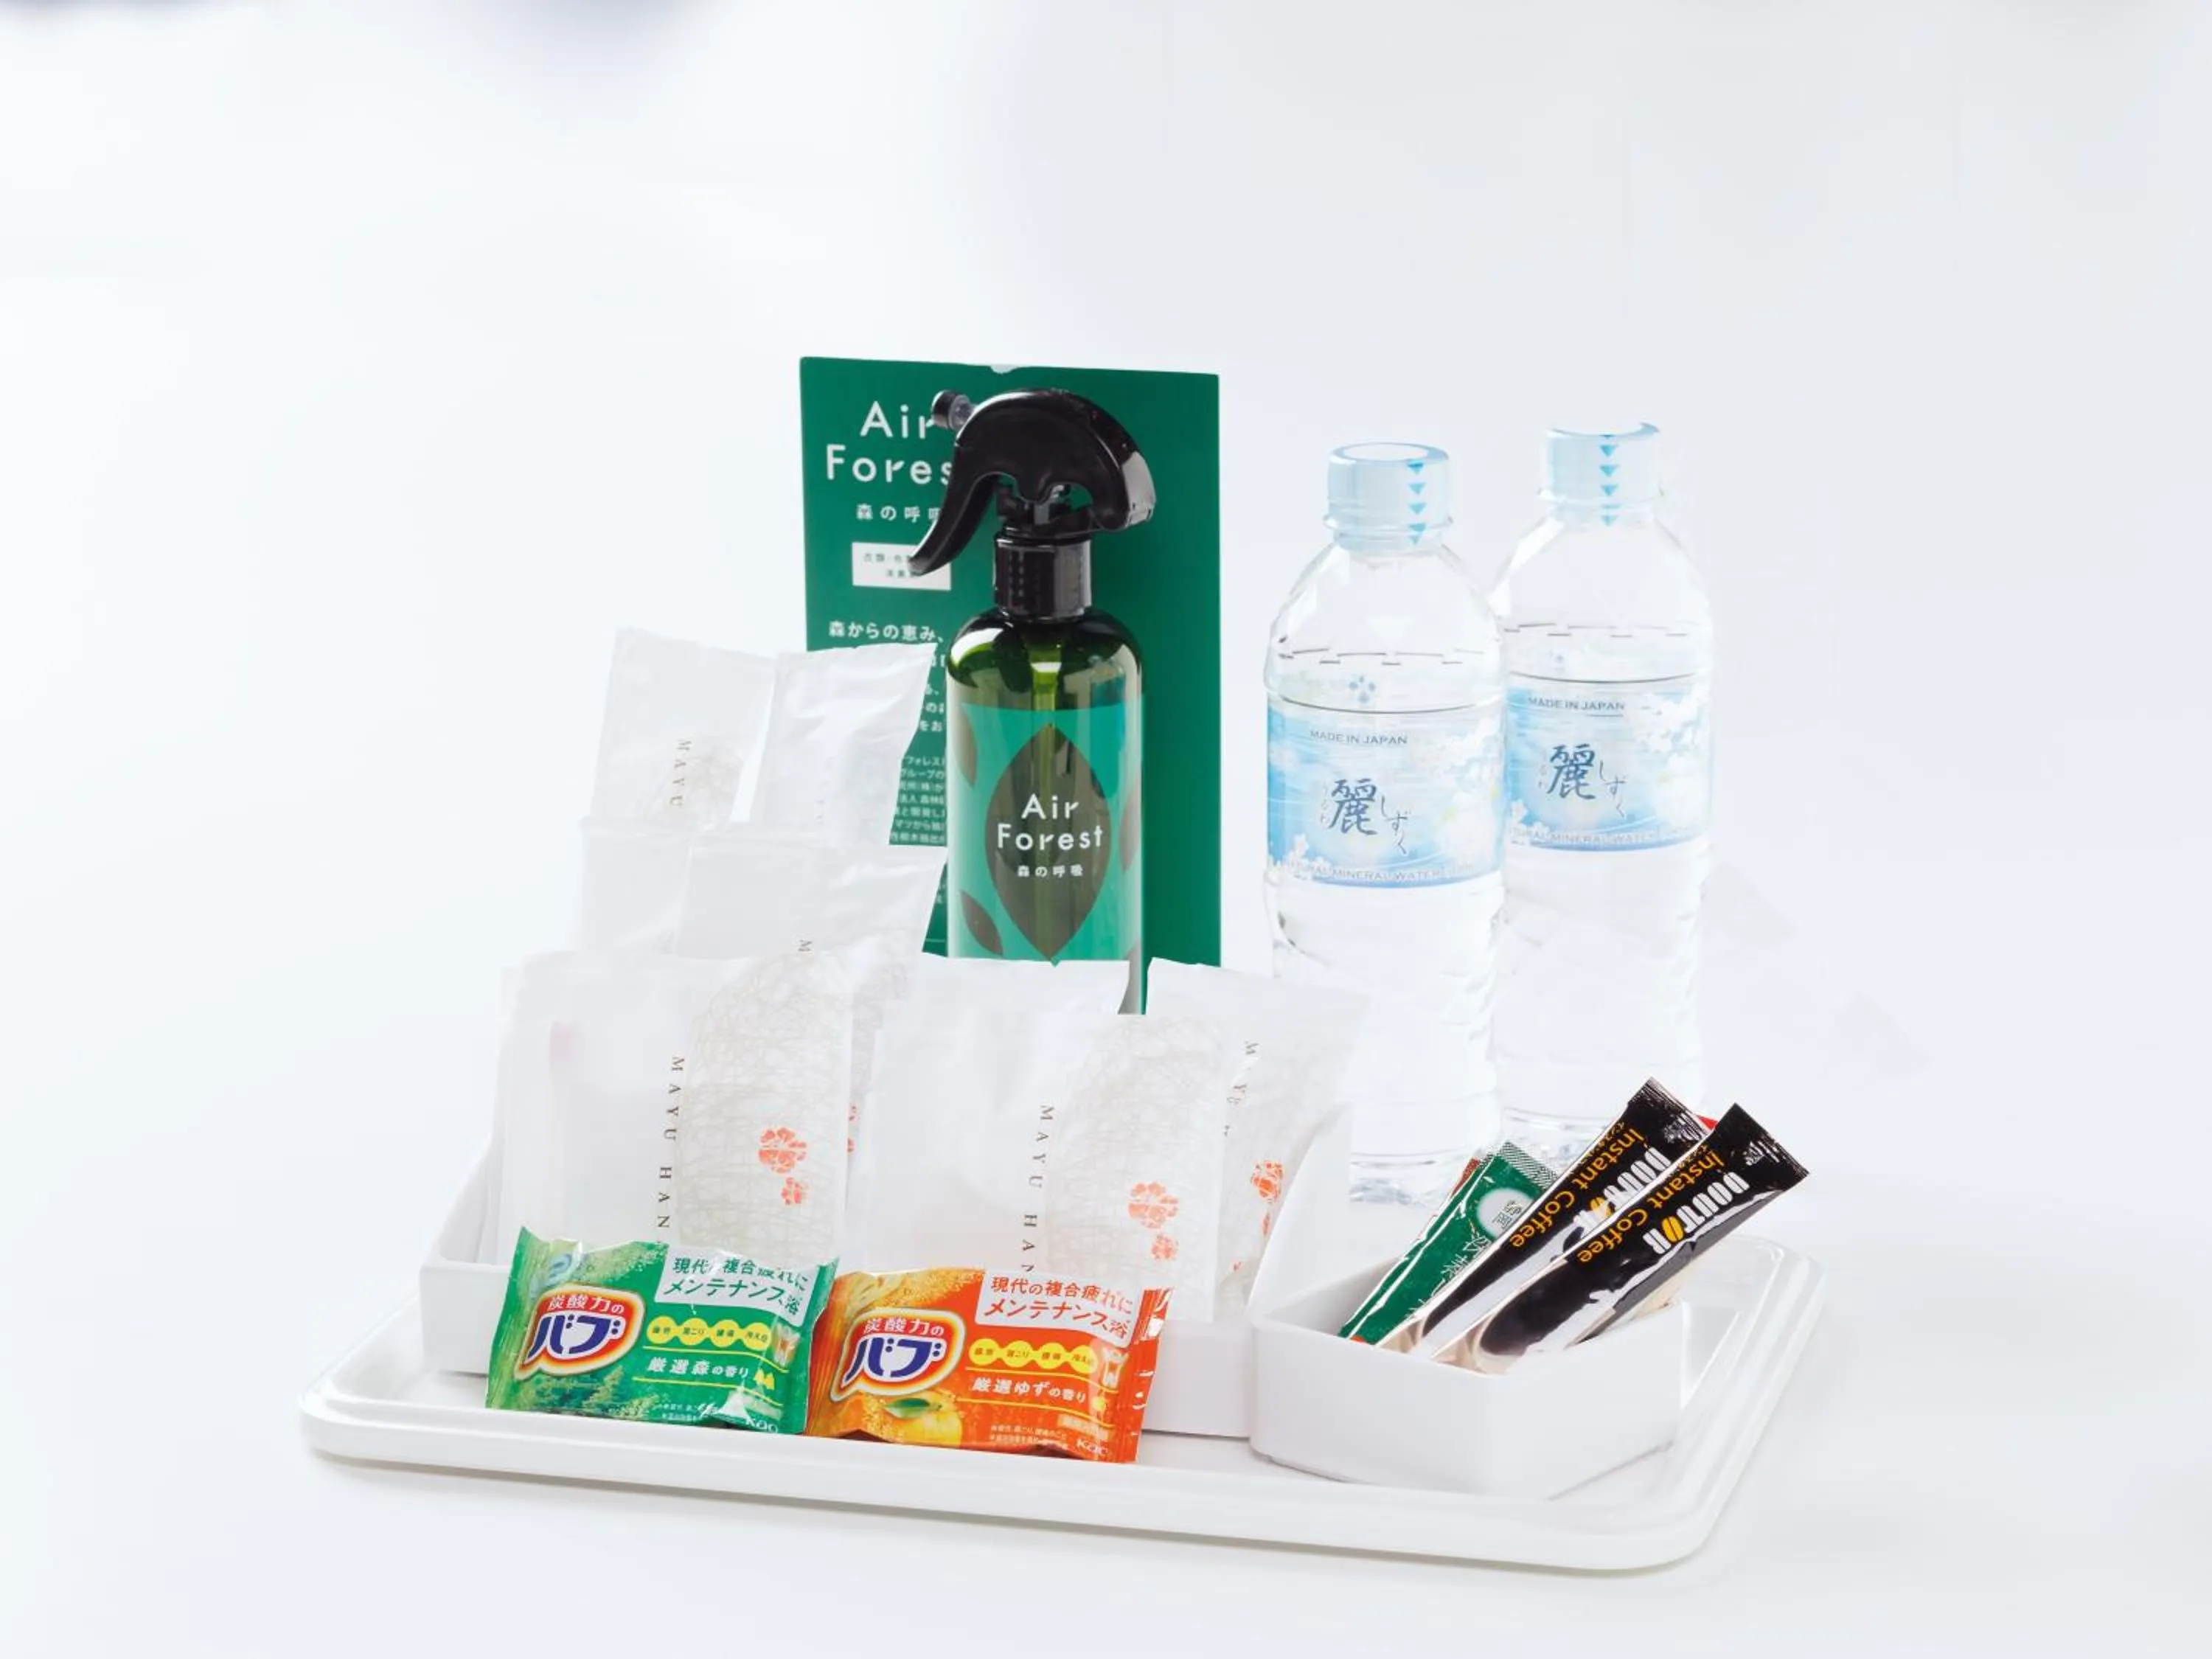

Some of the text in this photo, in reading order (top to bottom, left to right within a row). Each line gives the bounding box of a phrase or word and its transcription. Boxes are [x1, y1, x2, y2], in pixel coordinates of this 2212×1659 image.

[860, 400, 935, 439] Air
[826, 443, 952, 485] Fores
[828, 619, 943, 643] 森からの恵み、
[1528, 697, 1625, 711] MADE IN JAPAN
[1310, 730, 1408, 745] MADE IN JAPAN
[1021, 793, 1079, 819] Air
[998, 823, 1103, 850] Forest
[657, 1057, 685, 1244] MAYU HAN
[1029, 1105, 1054, 1188] MAYU
[1571, 1128, 1645, 1189] Instant
[1646, 1150, 1725, 1208] Instant
[1510, 1191, 1576, 1247] Coffee
[1642, 1172, 1750, 1254] DOUTOR
[1577, 1208, 1648, 1262] Coffee
[672, 1257, 809, 1291] 現代複合れに
[546, 1294, 625, 1314] 炭酸力の
[664, 1279, 803, 1315] メンテナンス浴
[991, 1276, 1133, 1314] 現代の複合疲れに
[527, 1315, 621, 1359] バブ
[863, 1317, 945, 1336] 炭酸力の
[984, 1298, 1131, 1339] メンテナンス浴
[844, 1337, 942, 1382] バブ
